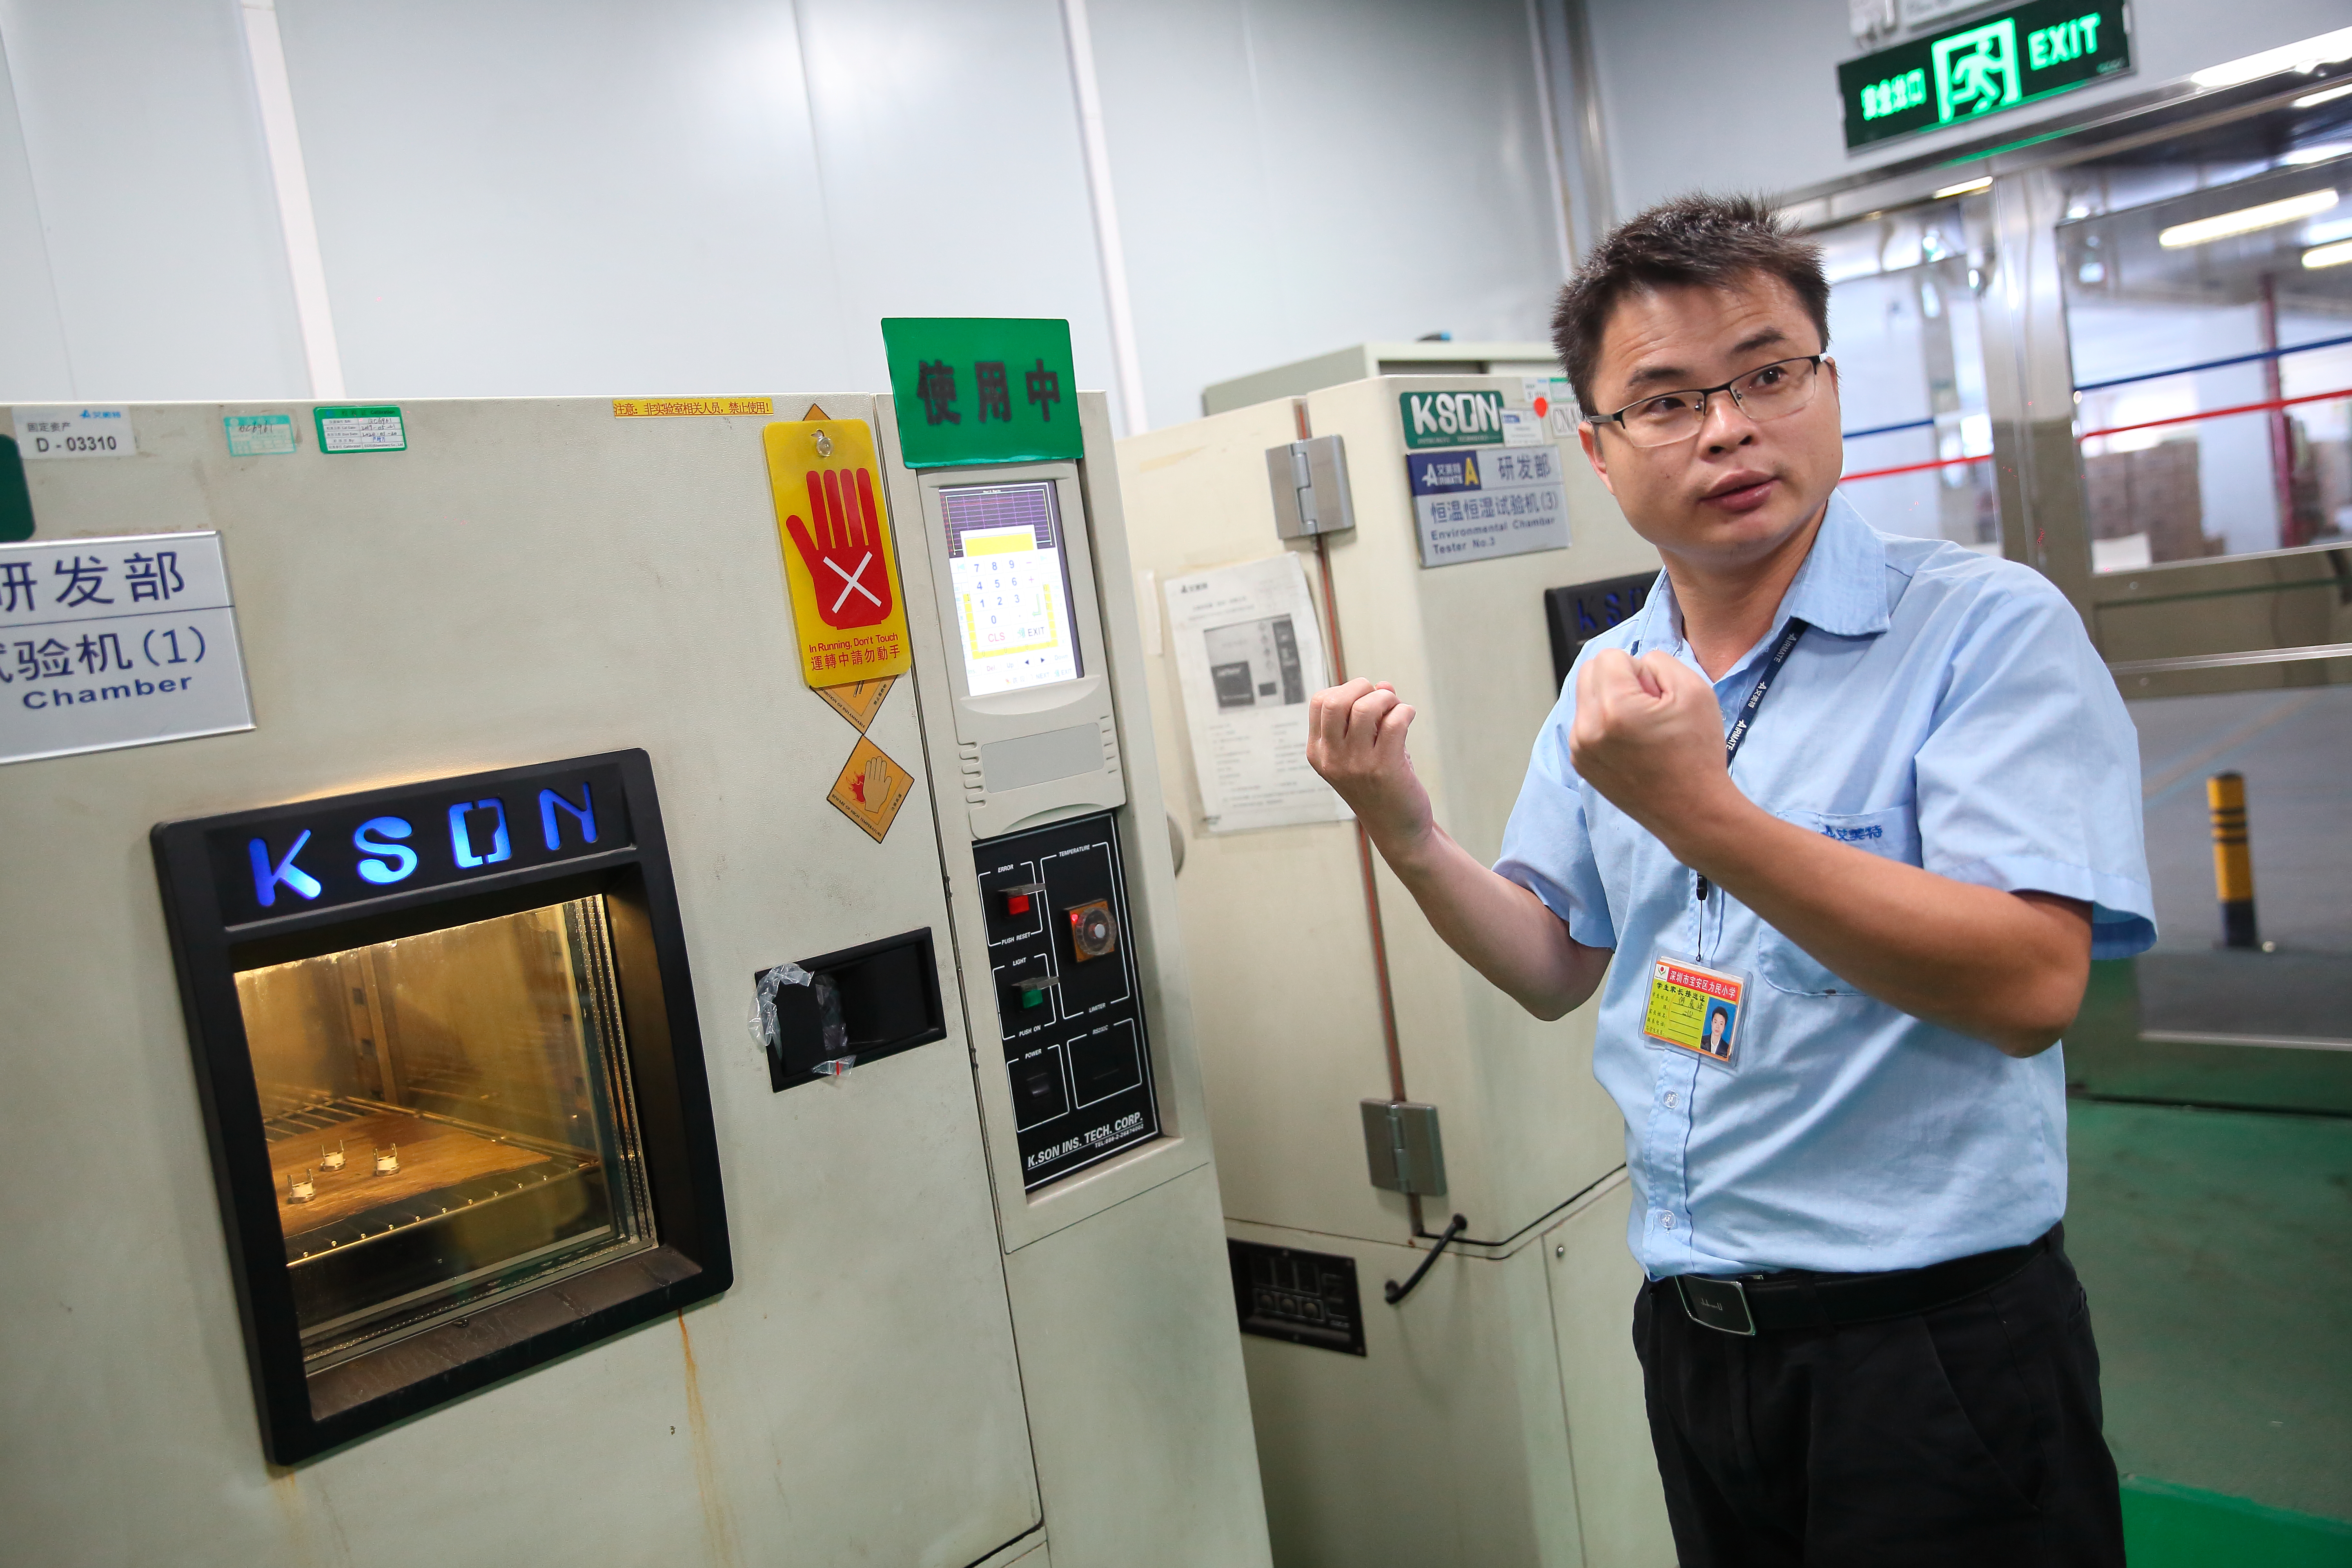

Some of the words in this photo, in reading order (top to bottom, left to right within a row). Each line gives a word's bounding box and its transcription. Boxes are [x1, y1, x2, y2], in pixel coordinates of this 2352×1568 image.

[2028, 11, 2102, 71] EXIT
[917, 359, 1060, 425] 使用中
[1410, 393, 1501, 435] KSON
[27, 422, 71, 432] 固定资产
[1497, 452, 1551, 481] 研发部
[1431, 522, 1508, 540] Environmental
[1512, 517, 1555, 530] Chamber
[1433, 542, 1466, 554] Tester
[974, 564, 980, 572] 7
[991, 562, 998, 570] 8
[1009, 560, 1015, 569] 9
[977, 581, 982, 590] 4
[995, 579, 1000, 588] 5
[1011, 577, 1017, 586] 6
[980, 599, 984, 608] 1
[997, 597, 1003, 605] 2
[1014, 595, 1020, 603] 3
[991, 615, 997, 624] 0
[809, 644, 816, 653] In
[818, 641, 852, 652] Running,
[853, 636, 873, 646] Don't
[876, 633, 898, 643] Touch
[988, 632, 1005, 642] CLS
[1027, 627, 1045, 637] EXIT
[811, 644, 900, 671] 運轉中請勿動手
[1774, 633, 1797, 663] AIRMATE
[23, 675, 193, 710] Chamber
[842, 706, 865, 728] INFLAMMABLE
[1726, 719, 1746, 751] AIRMATE
[832, 794, 845, 806] BEWARE
[851, 809, 860, 818] HIGH
[860, 817, 882, 836] TEMPERATURE
[248, 781, 598, 907] KSON
[1059, 844, 1090, 857] TEMPERATURE
[998, 864, 1014, 873] ERROR
[1002, 936, 1014, 945] PUSH
[1016, 931, 1031, 941] RESET
[1013, 957, 1027, 966] LIGHT
[1656, 982, 1706, 1003] 学生家长接送证
[1669, 970, 1736, 998] 深圳市宝安区为民小学
[1089, 1002, 1106, 1013] LIMITER
[1019, 1028, 1032, 1037] PUSH
[1025, 1049, 1042, 1059] POWER
[1028, 1144, 1060, 1167] K.SON
[1062, 1136, 1082, 1154] INS.
[1084, 1124, 1112, 1144] TECH.
[1114, 1111, 1143, 1131] CORP.
